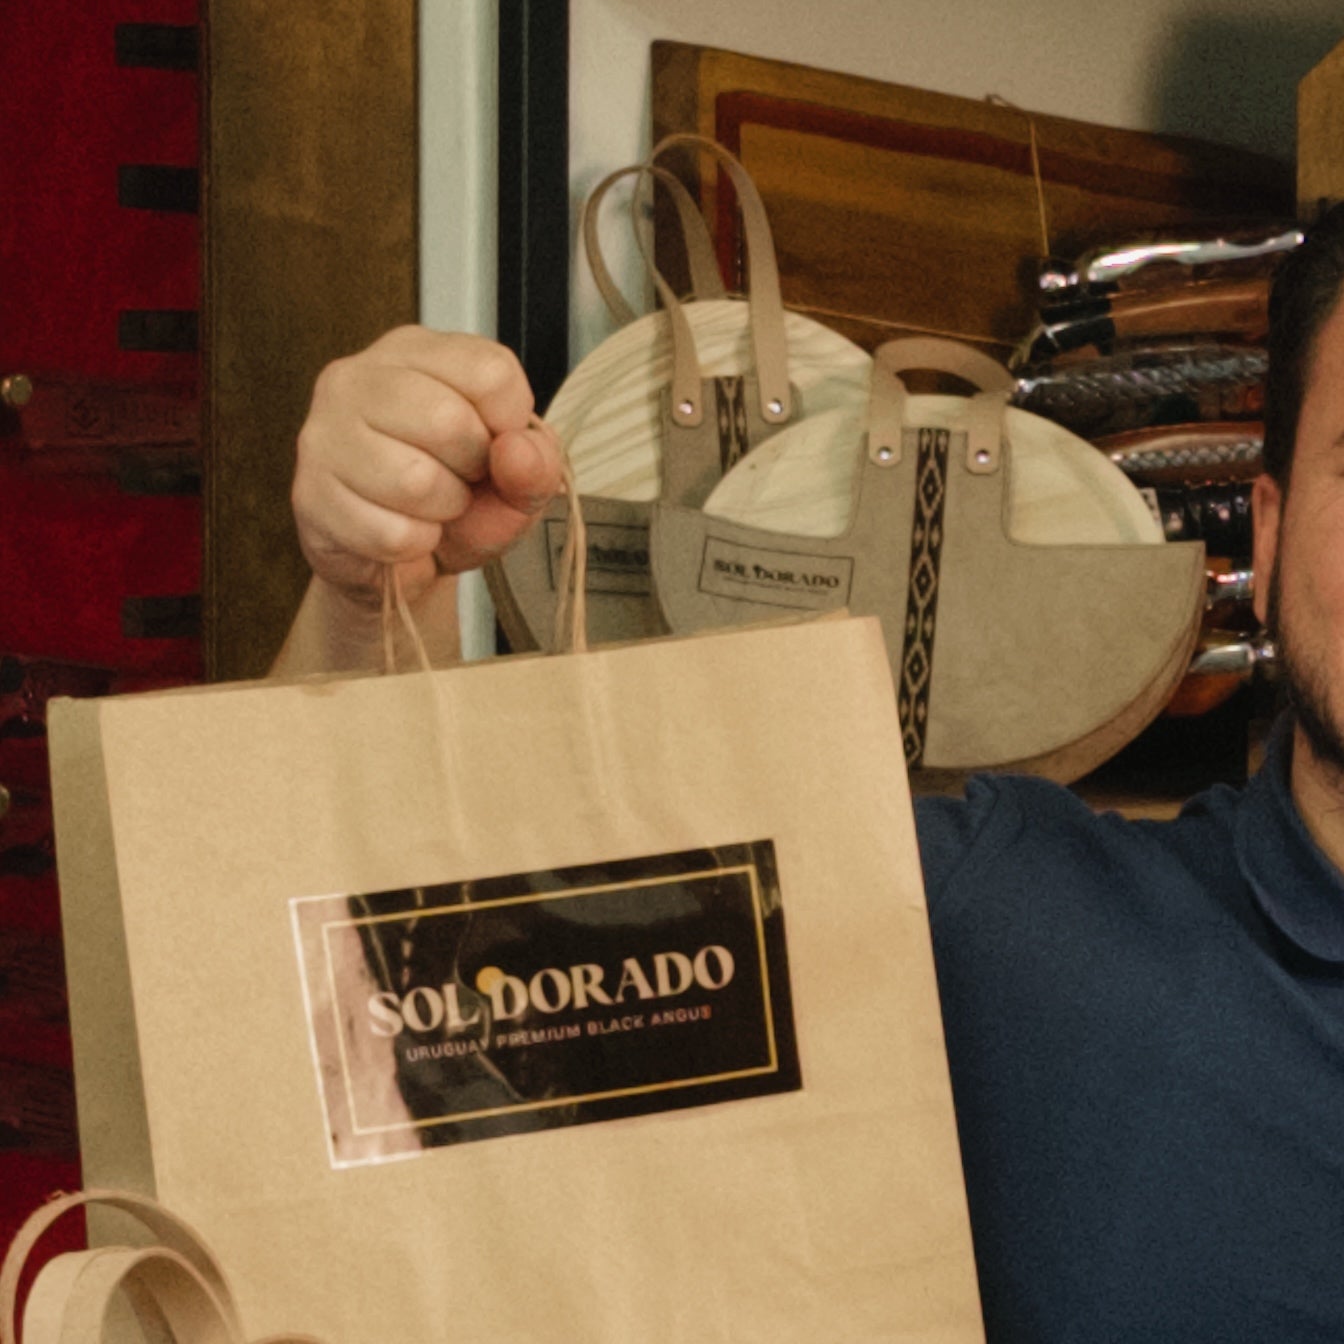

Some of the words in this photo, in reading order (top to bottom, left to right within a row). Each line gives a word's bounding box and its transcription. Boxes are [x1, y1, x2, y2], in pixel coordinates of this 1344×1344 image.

[367, 982, 478, 1038] SOL
[488, 944, 735, 1022] DORADO
[405, 1037, 490, 1064] URUGUAY
[496, 1024, 581, 1049] PREMIUM
[586, 1015, 645, 1036] BLACK
[650, 1004, 712, 1027] ANGUS
